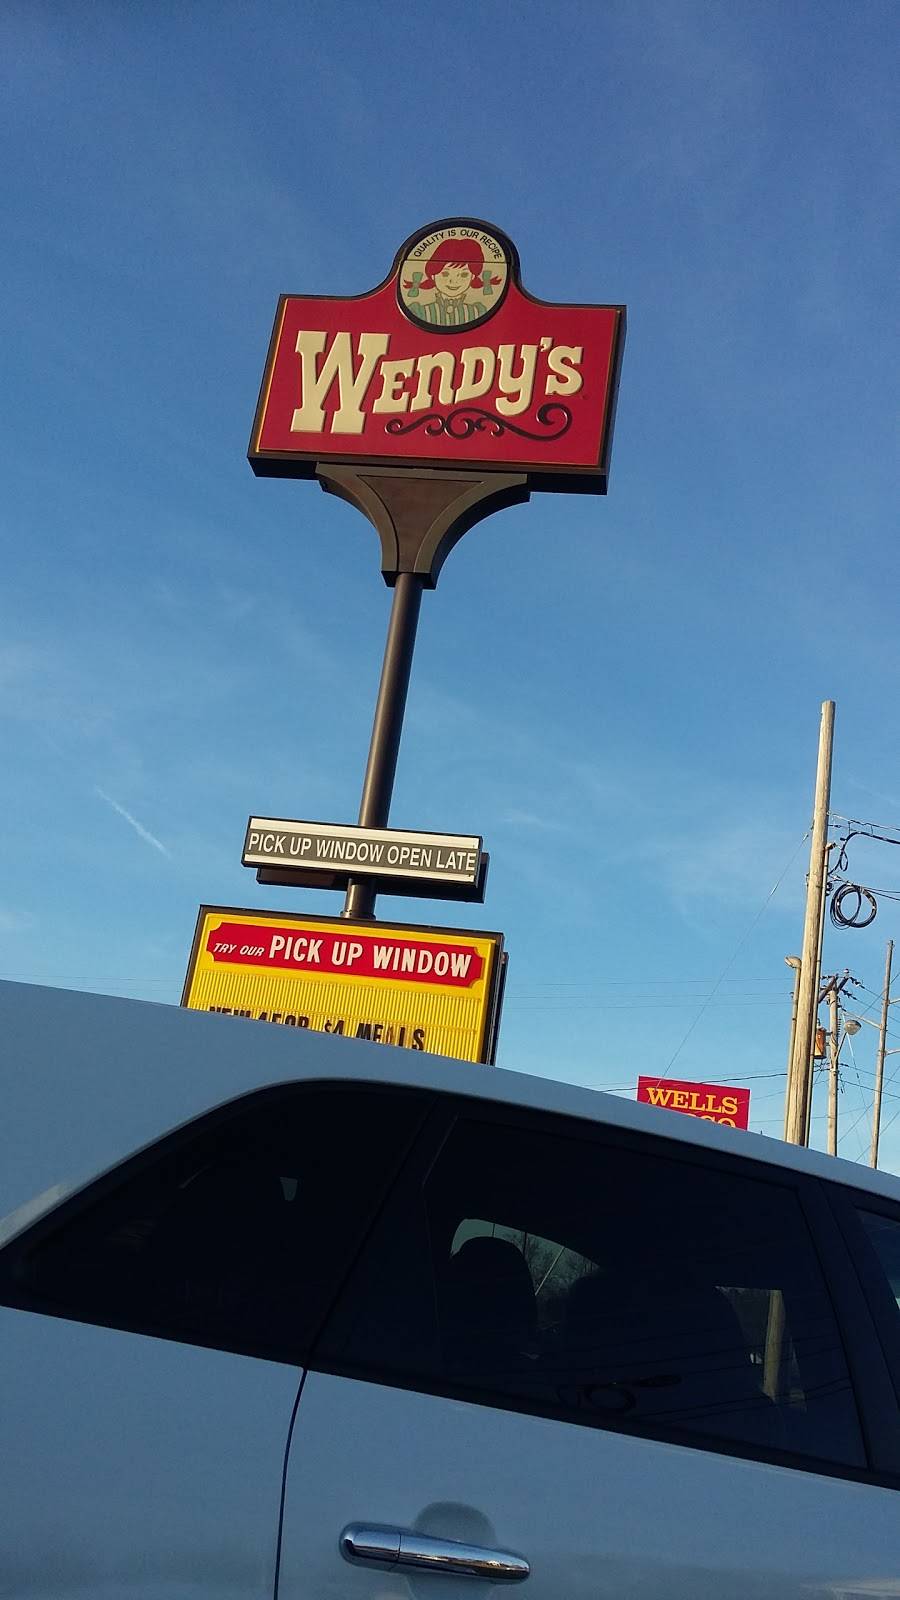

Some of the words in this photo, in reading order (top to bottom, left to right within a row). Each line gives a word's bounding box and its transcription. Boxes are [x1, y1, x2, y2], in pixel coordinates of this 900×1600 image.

[414, 232, 445, 257] QUALITY
[447, 229, 457, 237] IS
[460, 229, 480, 239] OUR
[480, 235, 503, 260] RECIPE
[248, 832, 286, 853] PICK
[289, 836, 312, 856] UP
[316, 839, 384, 863] WINDOW
[387, 845, 432, 867] OPEN
[436, 850, 476, 871] LATE
[213, 942, 237, 953] TRY
[239, 945, 265, 956] OUR
[269, 935, 323, 963] PICK
[331, 941, 363, 966] UP
[373, 945, 472, 978] WINDOW
[646, 1087, 738, 1115] WELLS
